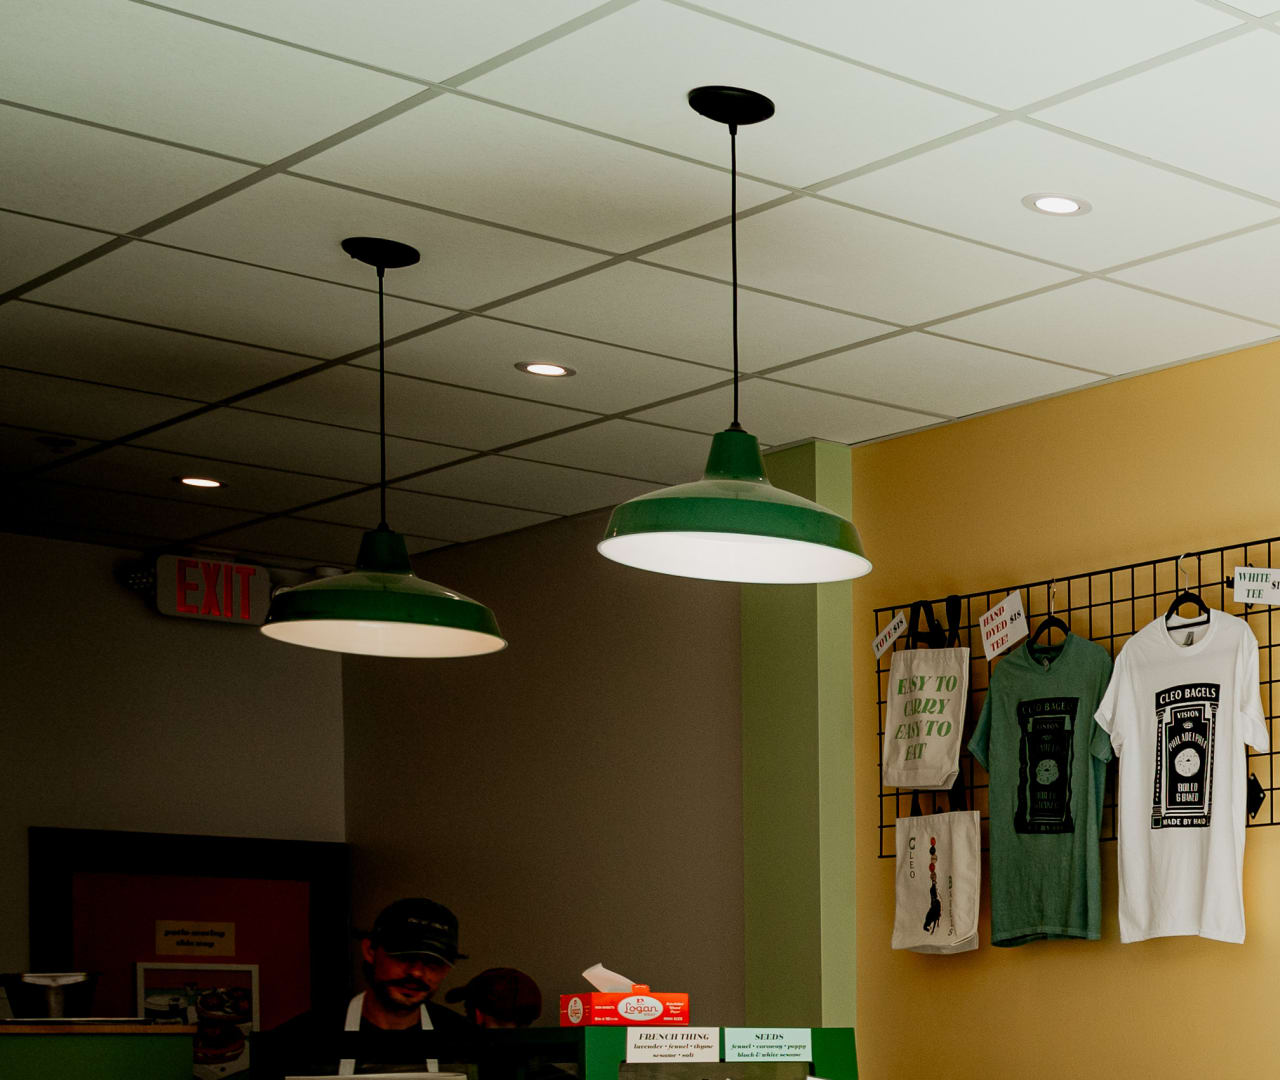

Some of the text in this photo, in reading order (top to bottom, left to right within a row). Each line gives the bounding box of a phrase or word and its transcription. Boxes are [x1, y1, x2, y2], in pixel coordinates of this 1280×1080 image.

[1239, 572, 1271, 583] WHITE
[176, 559, 256, 620] EXIT
[1246, 588, 1264, 598] TEE
[983, 606, 1005, 627] HAND
[985, 620, 1008, 641] DYED
[876, 629, 893, 652] TOTE
[990, 634, 1009, 652] TEE!
[897, 675, 958, 695] EASY TO
[1159, 687, 1217, 704] CLEO BAGELS
[904, 698, 950, 717] CARRY
[1177, 711, 1199, 719] VISION
[895, 720, 952, 740] EASY TO
[905, 743, 927, 761] EAT
[624, 1002, 658, 1015] Logan
[639, 1033, 680, 1041] FRENCH
